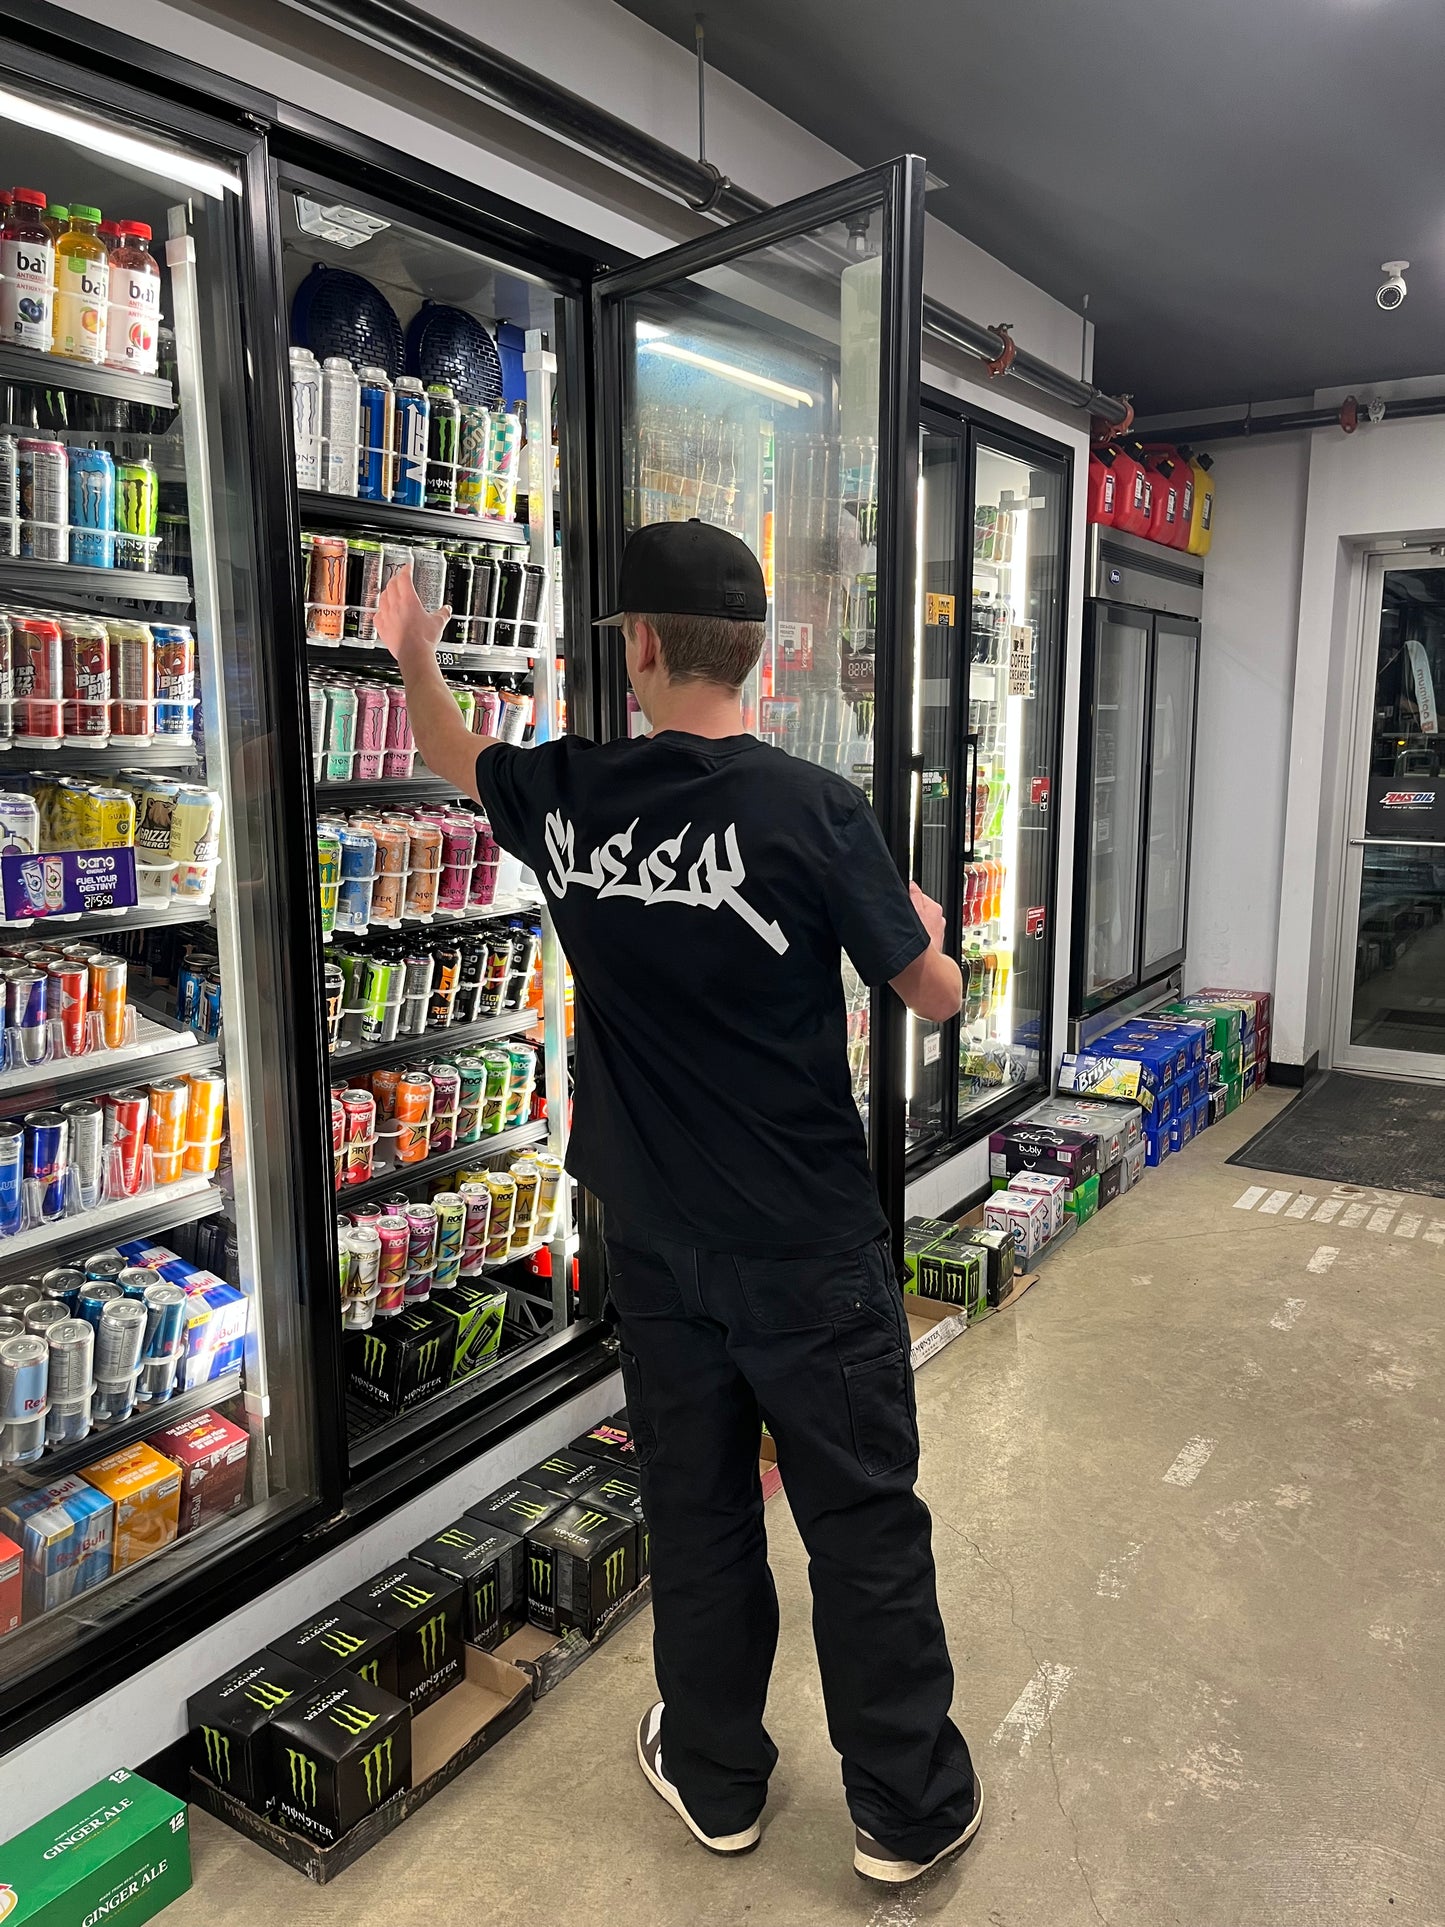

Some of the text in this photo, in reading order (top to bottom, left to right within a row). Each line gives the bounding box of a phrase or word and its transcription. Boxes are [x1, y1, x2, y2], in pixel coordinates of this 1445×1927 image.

[17, 252, 46, 274] bai
[1010, 654, 1029, 669] COFFEE
[1013, 682, 1025, 695] HERE
[1381, 792, 1436, 804] AMSOIL
[77, 855, 115, 871] bang
[76, 874, 118, 885] FUEL YOUR
[1123, 1089, 1133, 1097] 12
[1019, 1143, 1042, 1156] bubly
[351, 1373, 389, 1402] MONSTER
[404, 1376, 442, 1401] MONSTER
[566, 1465, 597, 1485] MONSTER
[48, 1480, 77, 1497] Bull
[488, 1490, 521, 1512] MONSTER
[82, 1529, 106, 1551] Bull
[553, 1526, 590, 1545] MONSTER
[462, 1536, 497, 1561] MONSTER
[297, 1616, 340, 1645] MONSTER
[219, 1666, 265, 1698] MONSTER
[409, 1659, 458, 1699] MONSTER
[303, 1688, 349, 1722] MONSTER
[108, 1770, 131, 1784] 12
[43, 1819, 105, 1860] GINGER
[103, 1798, 134, 1821] ALE
[169, 1812, 185, 1829] 12
[224, 1800, 290, 1850] MONSTER
[281, 1801, 334, 1840] MONSTER
[82, 1859, 168, 1927] GINGER ALE
